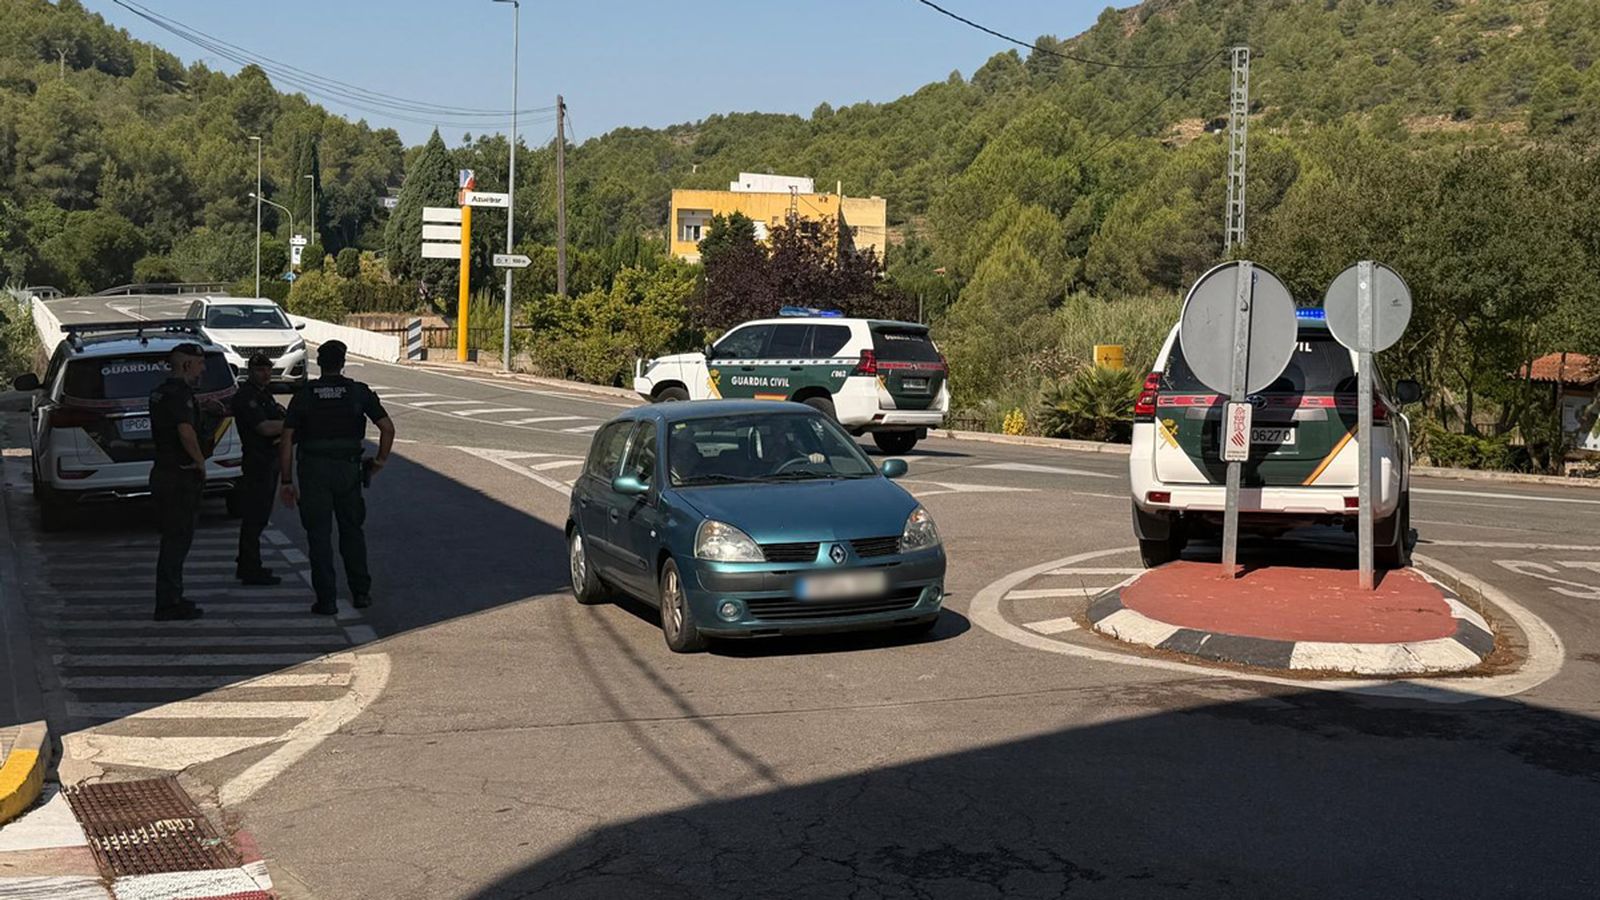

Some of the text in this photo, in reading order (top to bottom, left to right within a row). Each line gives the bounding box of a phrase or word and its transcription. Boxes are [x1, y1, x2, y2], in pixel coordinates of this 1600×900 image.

[101, 362, 160, 376] GUARDIA
[731, 376, 790, 388] GUARDIA CIVIL
[1251, 429, 1281, 442] 0627
